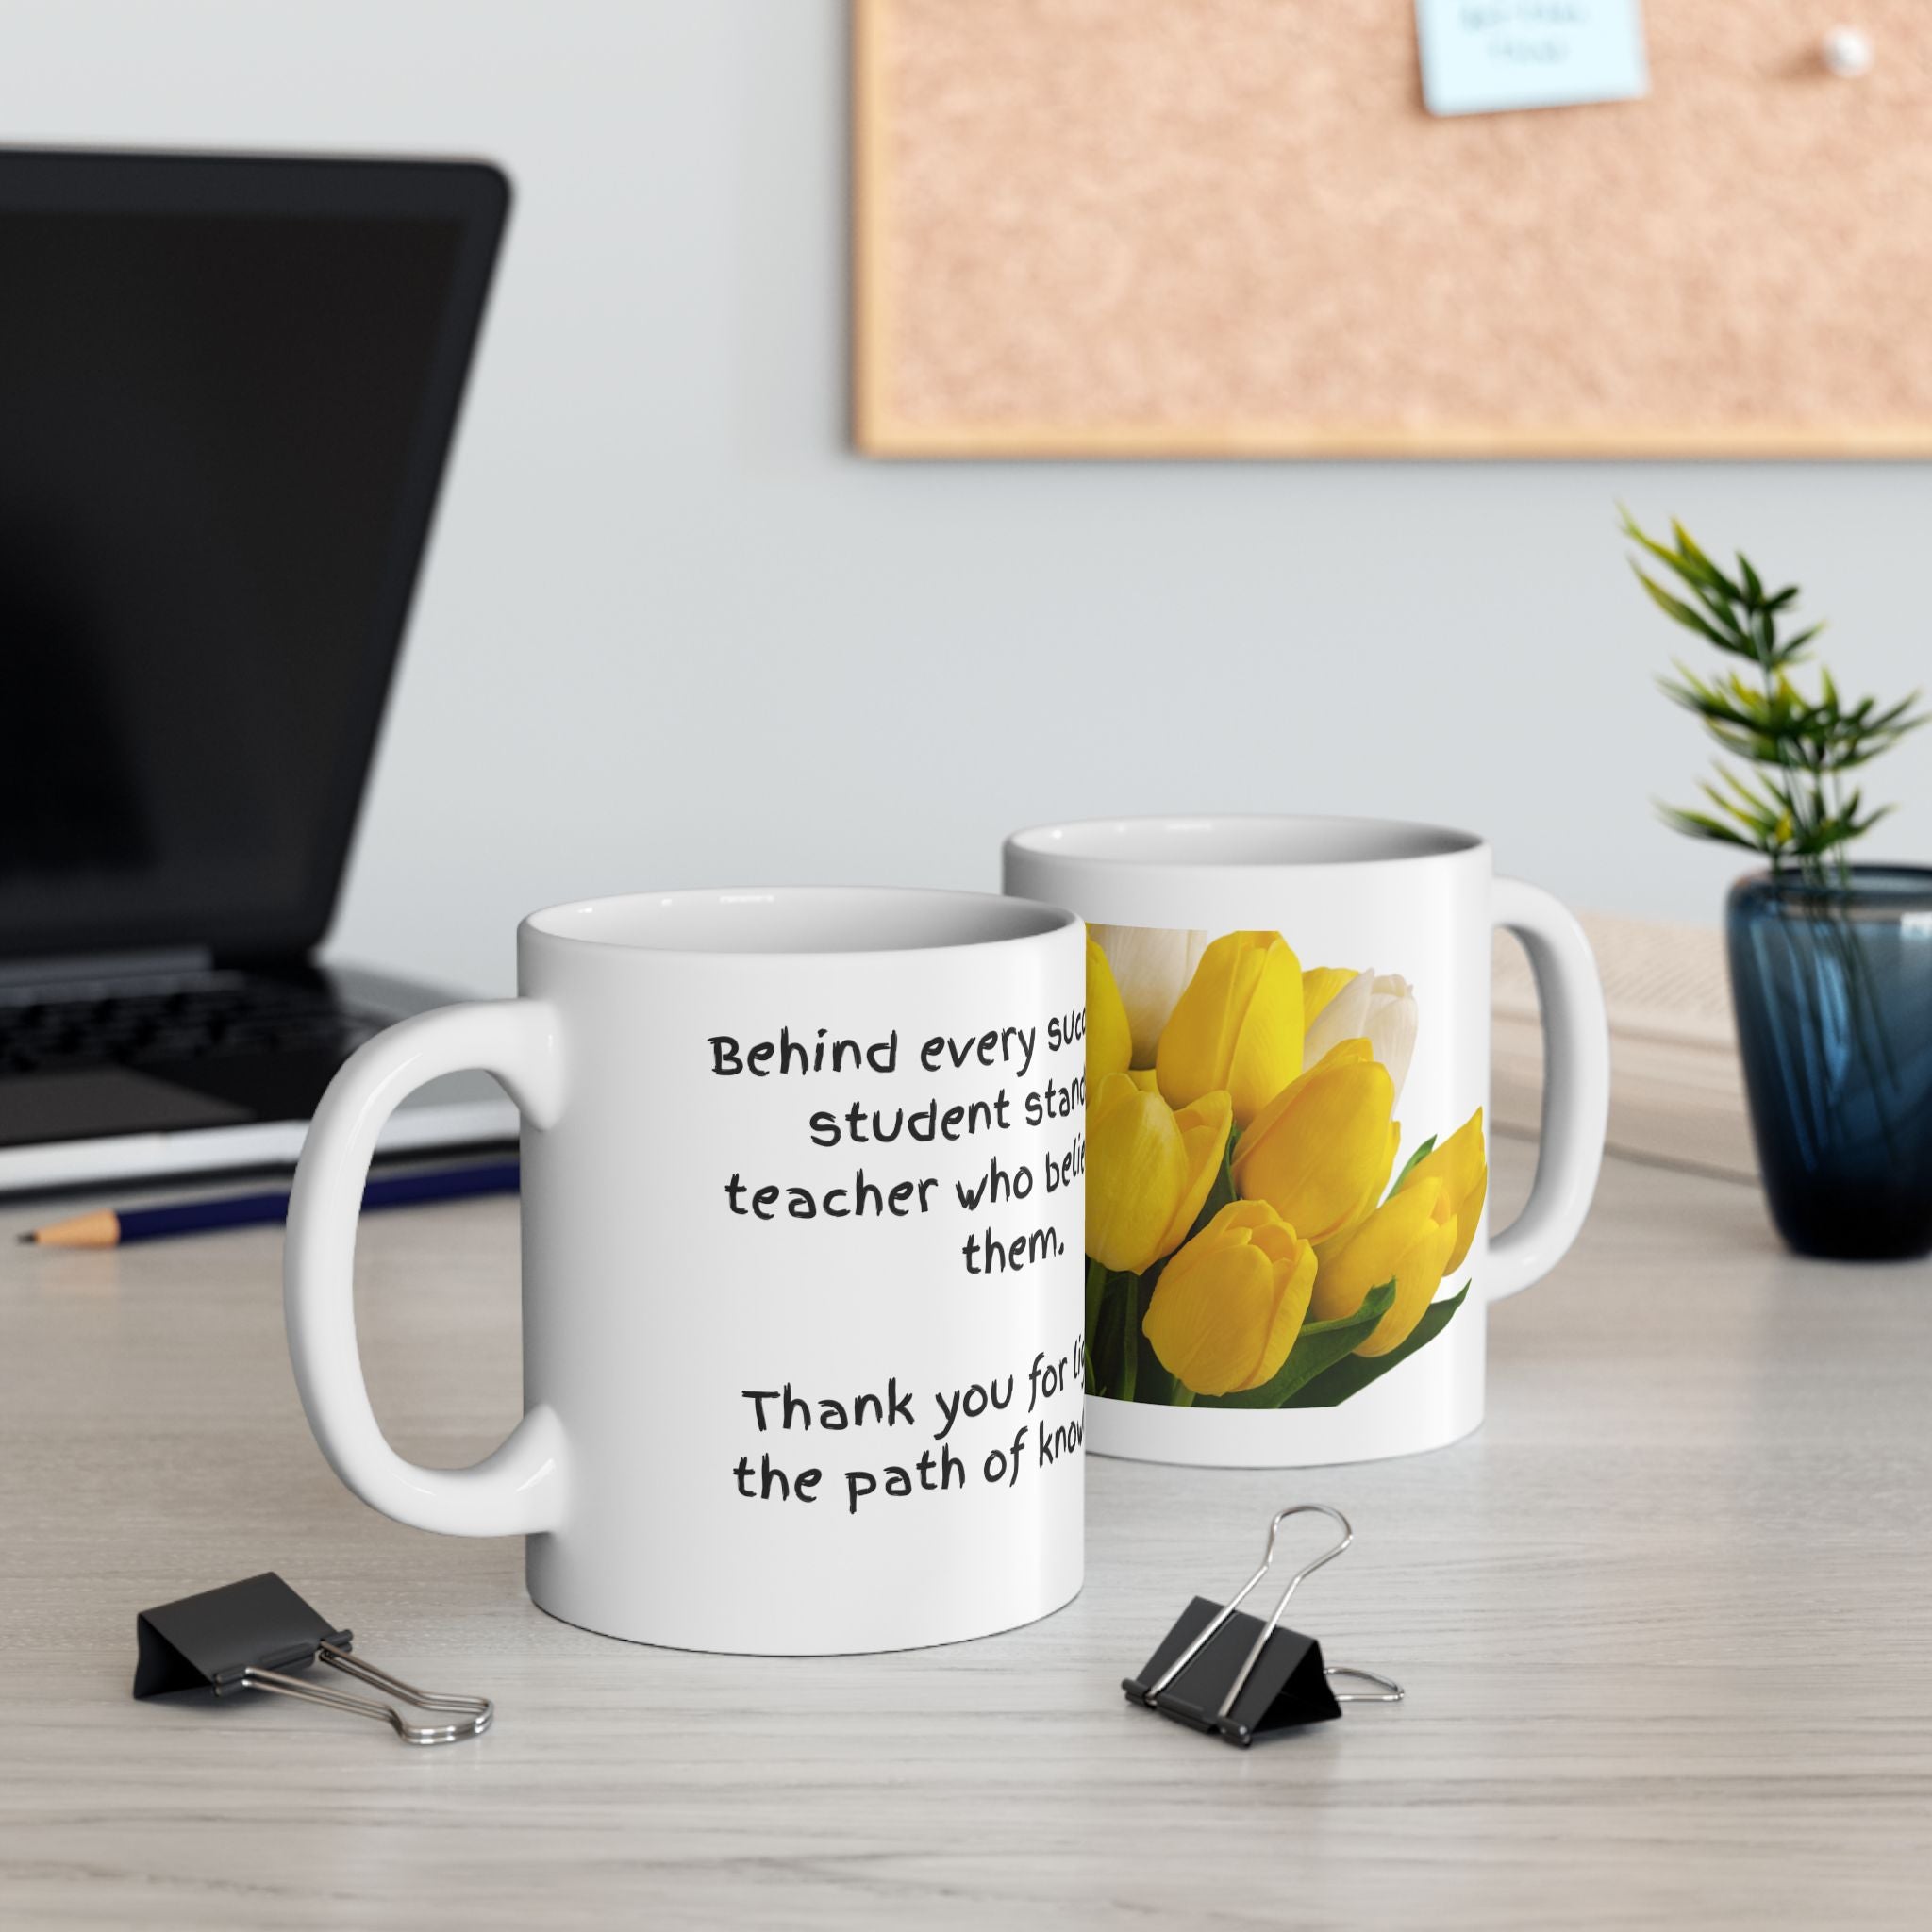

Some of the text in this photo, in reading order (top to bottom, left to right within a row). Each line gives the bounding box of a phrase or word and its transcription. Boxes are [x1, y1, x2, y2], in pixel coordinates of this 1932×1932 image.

[707, 1025, 898, 1077] Behind
[920, 1026, 1036, 1078] every
[808, 1088, 1011, 1148] student
[724, 1168, 939, 1221] teacher
[955, 1156, 1034, 1212] who
[961, 1226, 1065, 1275] them.
[741, 1377, 916, 1432] Thank
[933, 1374, 1014, 1441] you
[1027, 1351, 1068, 1414] for
[732, 1452, 823, 1504] the
[844, 1442, 967, 1515] path
[983, 1425, 1029, 1489] of
